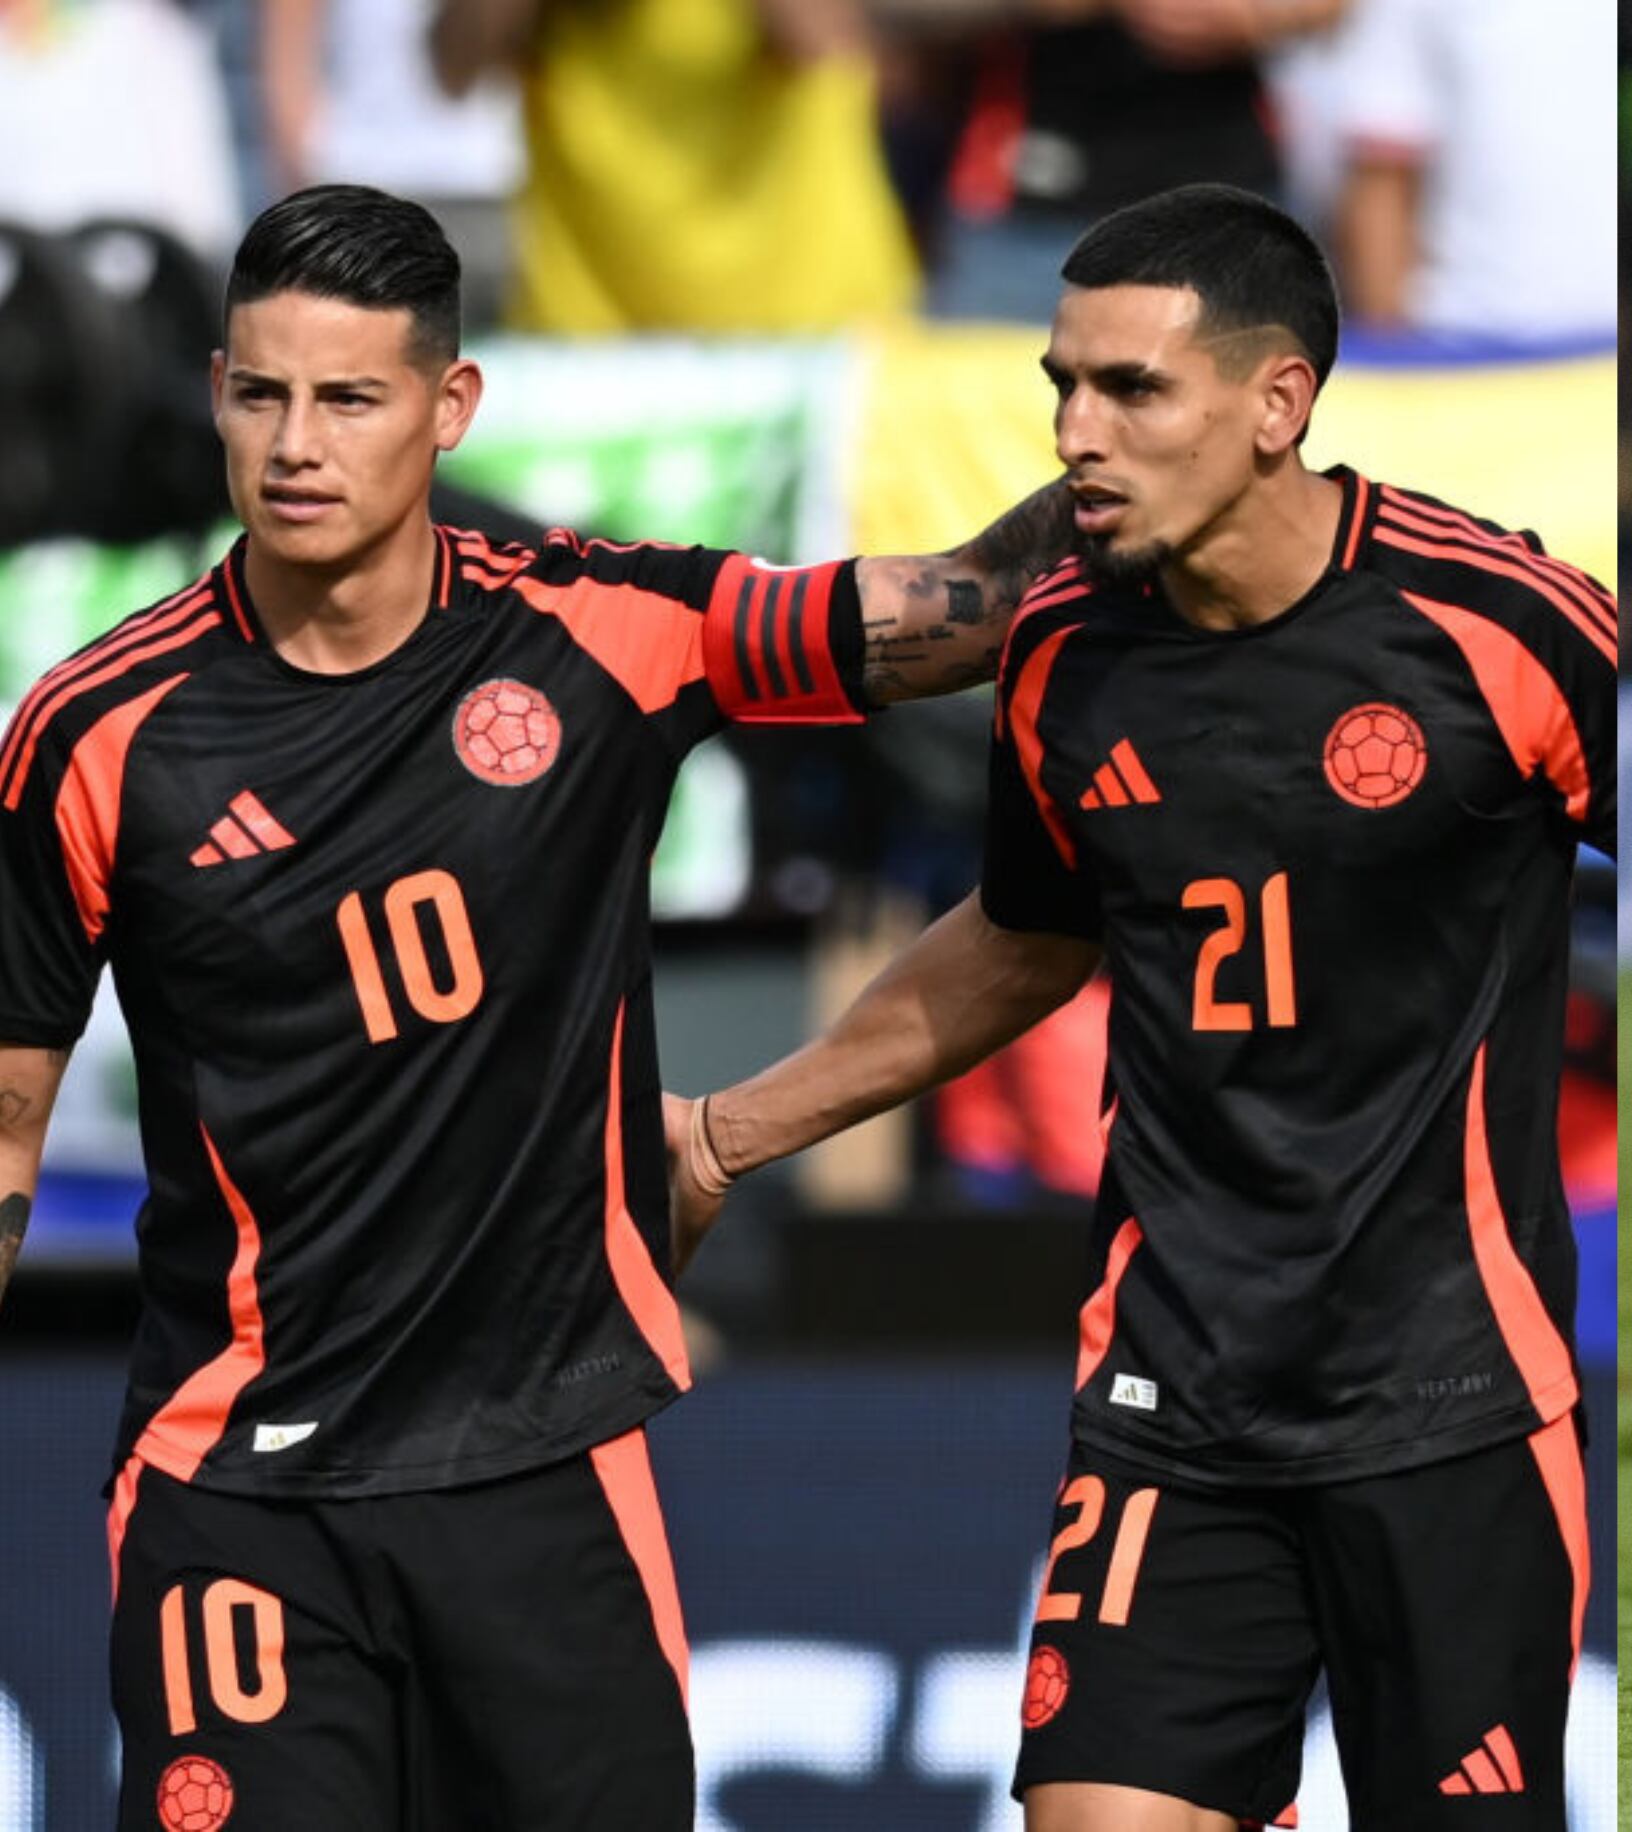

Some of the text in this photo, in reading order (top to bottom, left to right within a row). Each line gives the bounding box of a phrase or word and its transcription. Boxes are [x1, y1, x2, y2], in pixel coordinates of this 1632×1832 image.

[336, 868, 484, 1044] 10
[1181, 871, 1297, 1031] 21
[1034, 1474, 1160, 1627] 21
[160, 1578, 288, 1737] 10
